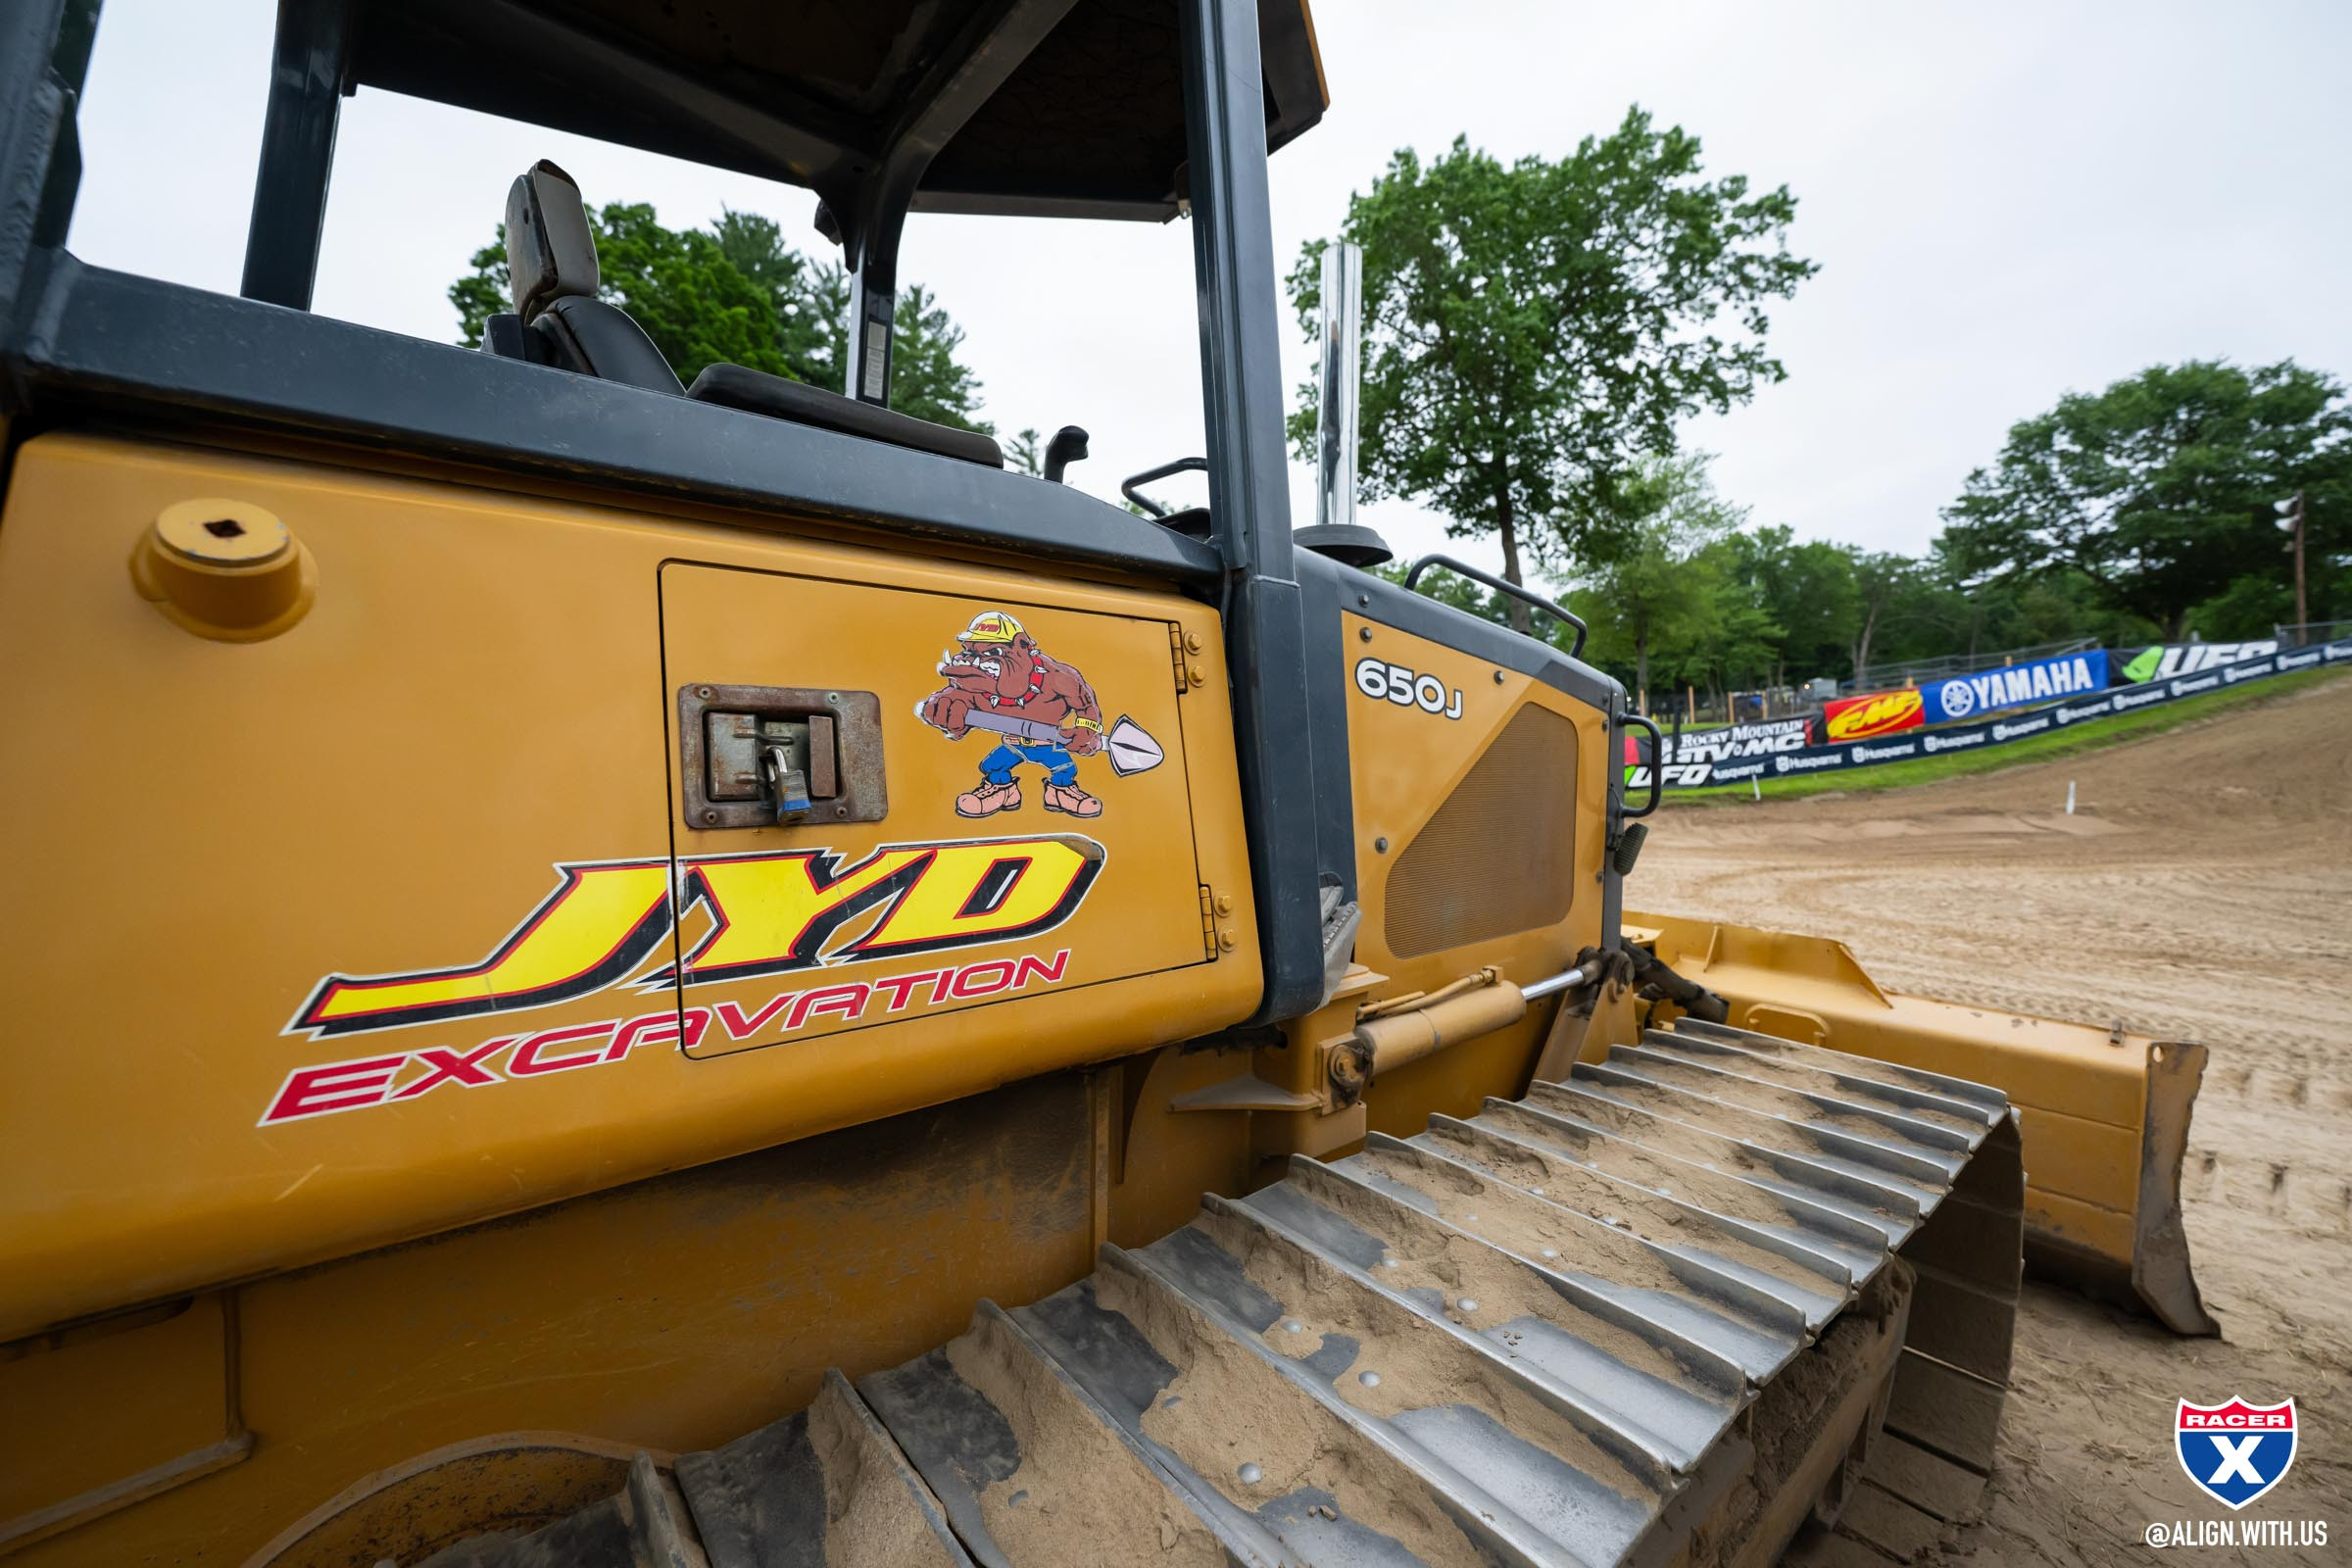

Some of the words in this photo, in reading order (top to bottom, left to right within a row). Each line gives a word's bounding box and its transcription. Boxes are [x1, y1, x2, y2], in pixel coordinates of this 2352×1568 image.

[1355, 657, 1463, 720] 650J
[1970, 658, 2093, 710] YAMAHA
[1681, 730, 1729, 748] ROCKY
[1732, 719, 1803, 742] MOUNTAIN
[1828, 690, 1922, 737] FMF
[281, 833, 1107, 1040] JYD
[257, 949, 1072, 1128] EXCAVATION
